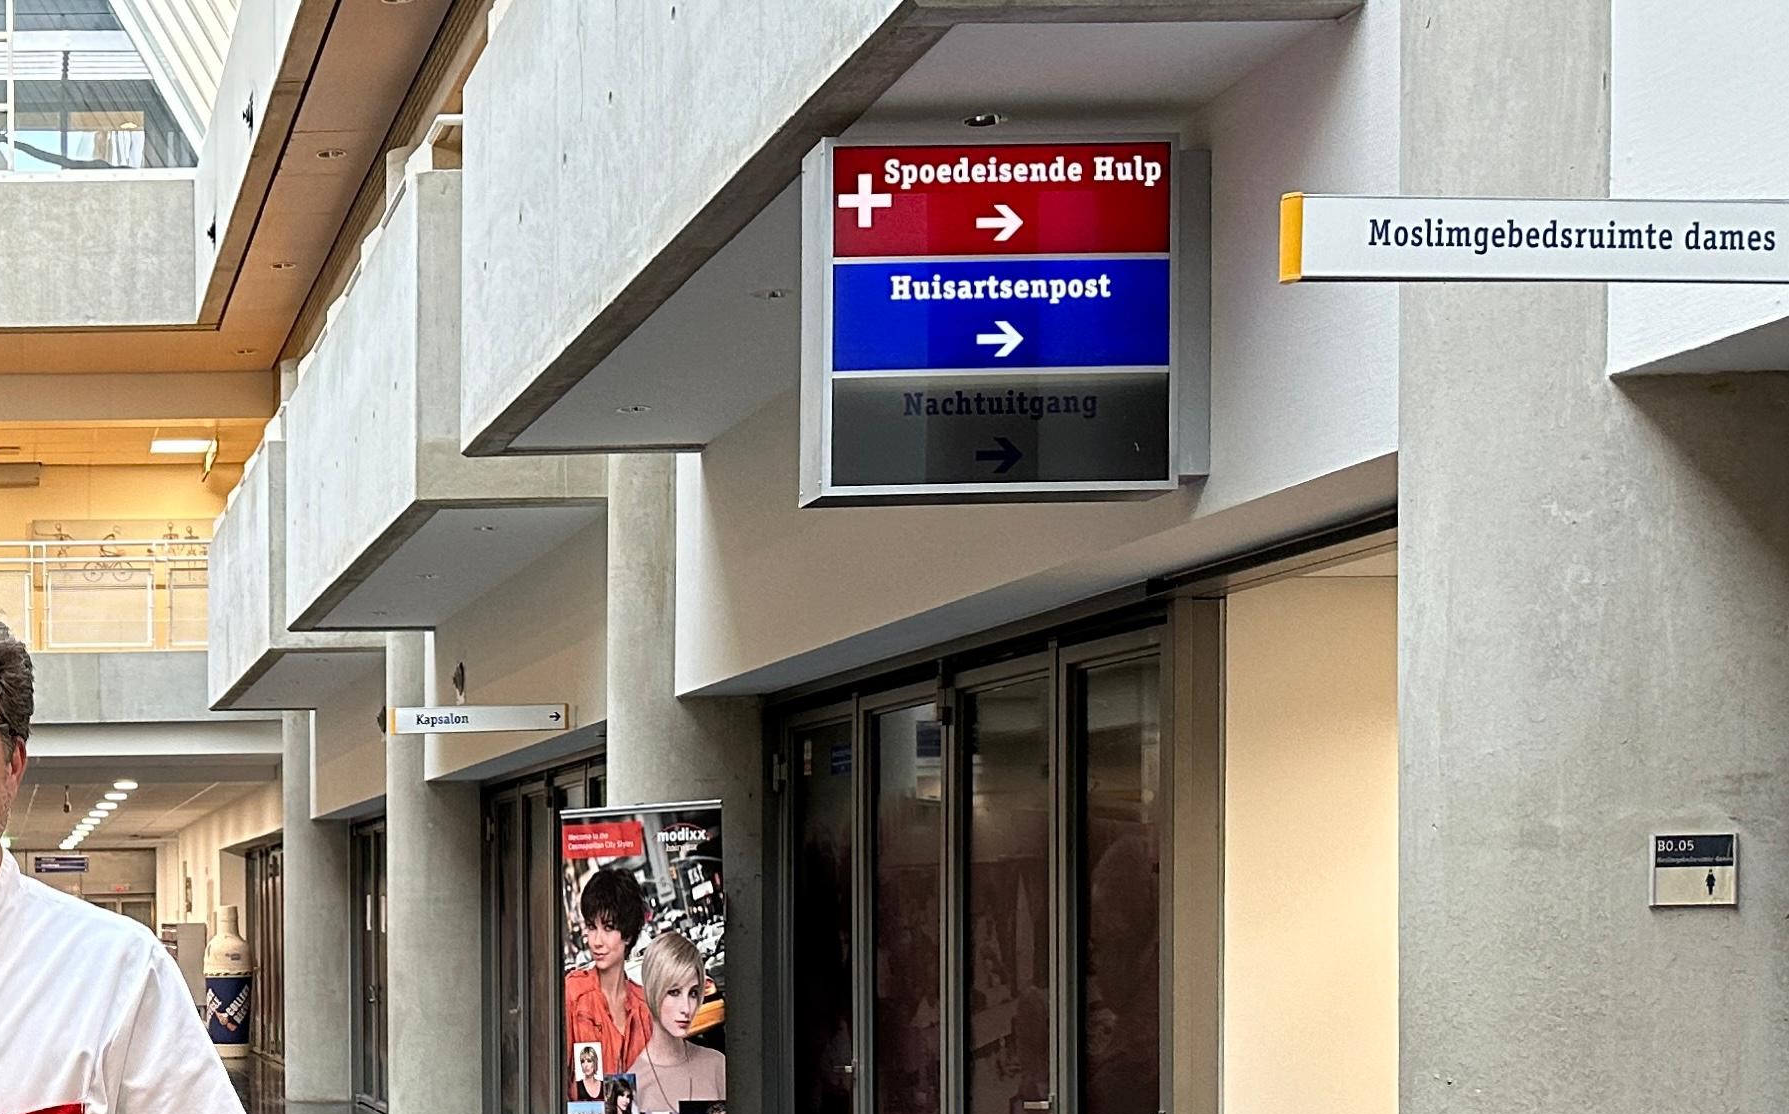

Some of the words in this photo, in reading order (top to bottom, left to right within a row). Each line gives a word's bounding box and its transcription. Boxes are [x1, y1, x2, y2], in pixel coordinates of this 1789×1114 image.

[884, 156, 1082, 190] Spoedeisende
[1093, 155, 1162, 187] Hulp
[1368, 218, 1673, 255] Moslimgebedsruimte
[1685, 221, 1776, 252] dames
[890, 273, 1112, 304] Huisartsenpost
[903, 390, 1098, 421] Nachtuitgang
[416, 712, 469, 727] Kapsalon
[1656, 839, 1695, 852] B0.05
